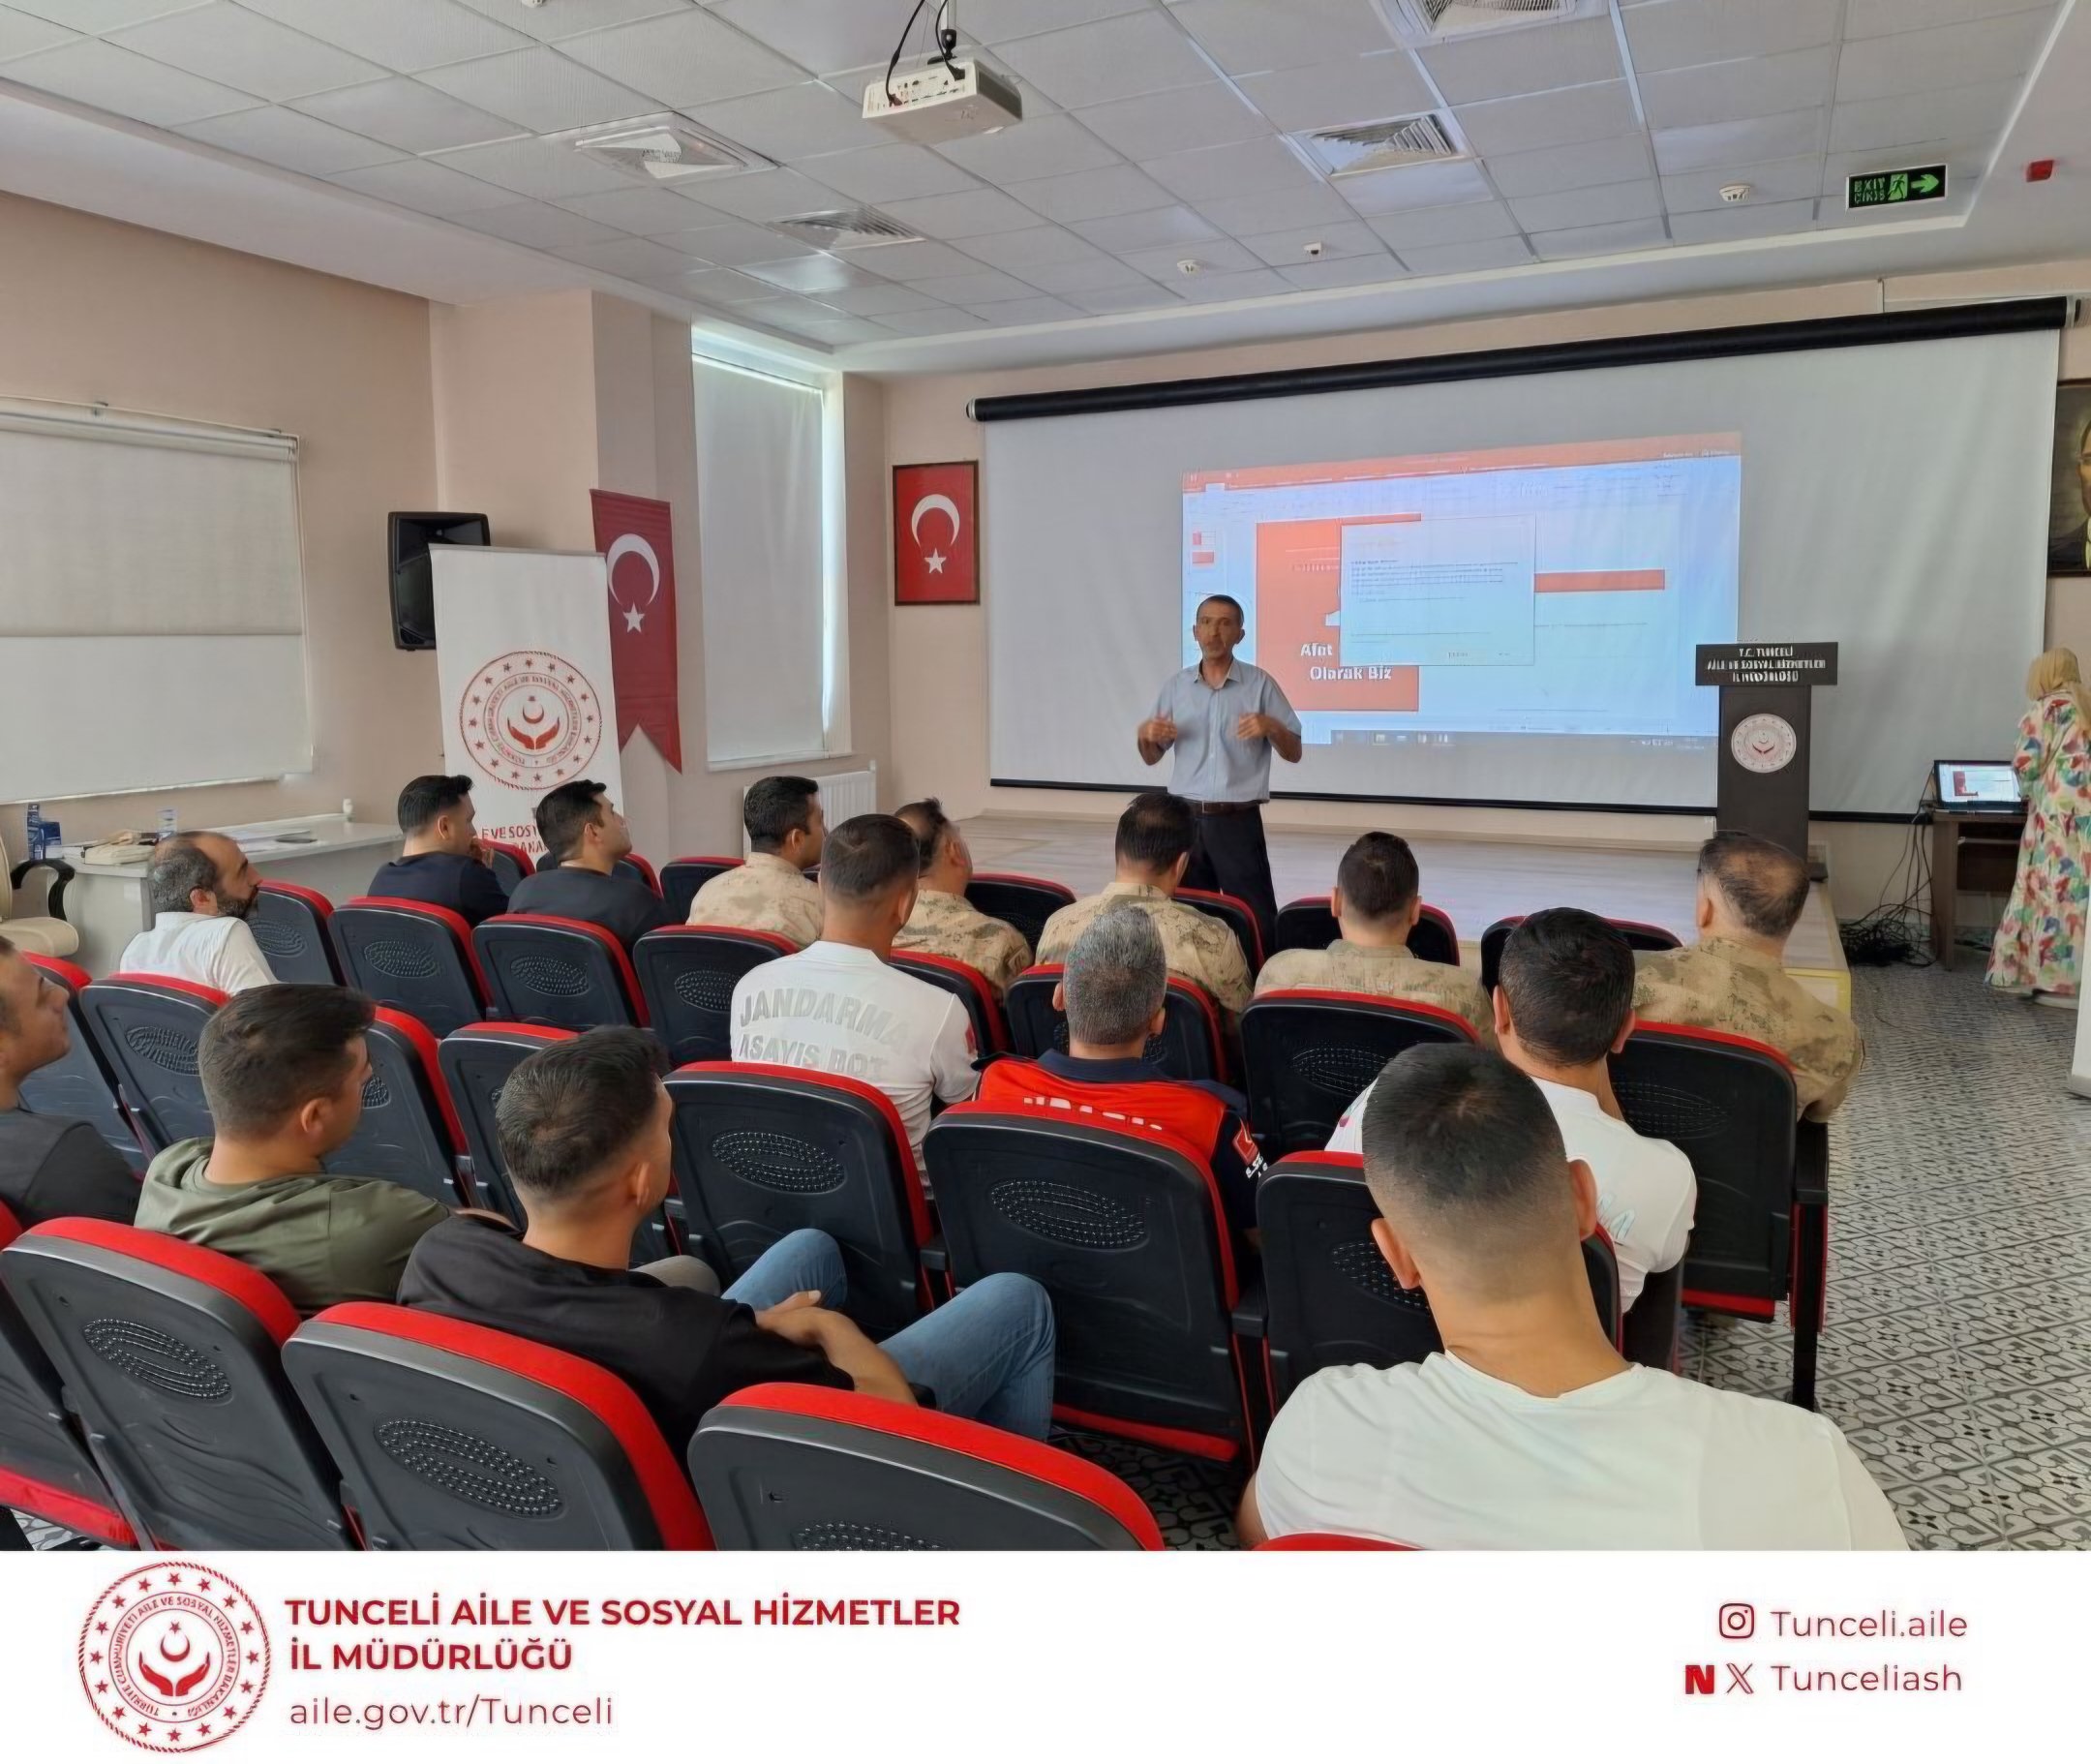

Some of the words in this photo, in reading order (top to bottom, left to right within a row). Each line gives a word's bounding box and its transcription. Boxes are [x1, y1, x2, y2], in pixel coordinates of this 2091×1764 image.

[1854, 177, 1886, 193] EXIT
[1368, 665, 1392, 680] Biz
[740, 988, 910, 1045] JANDARMA
